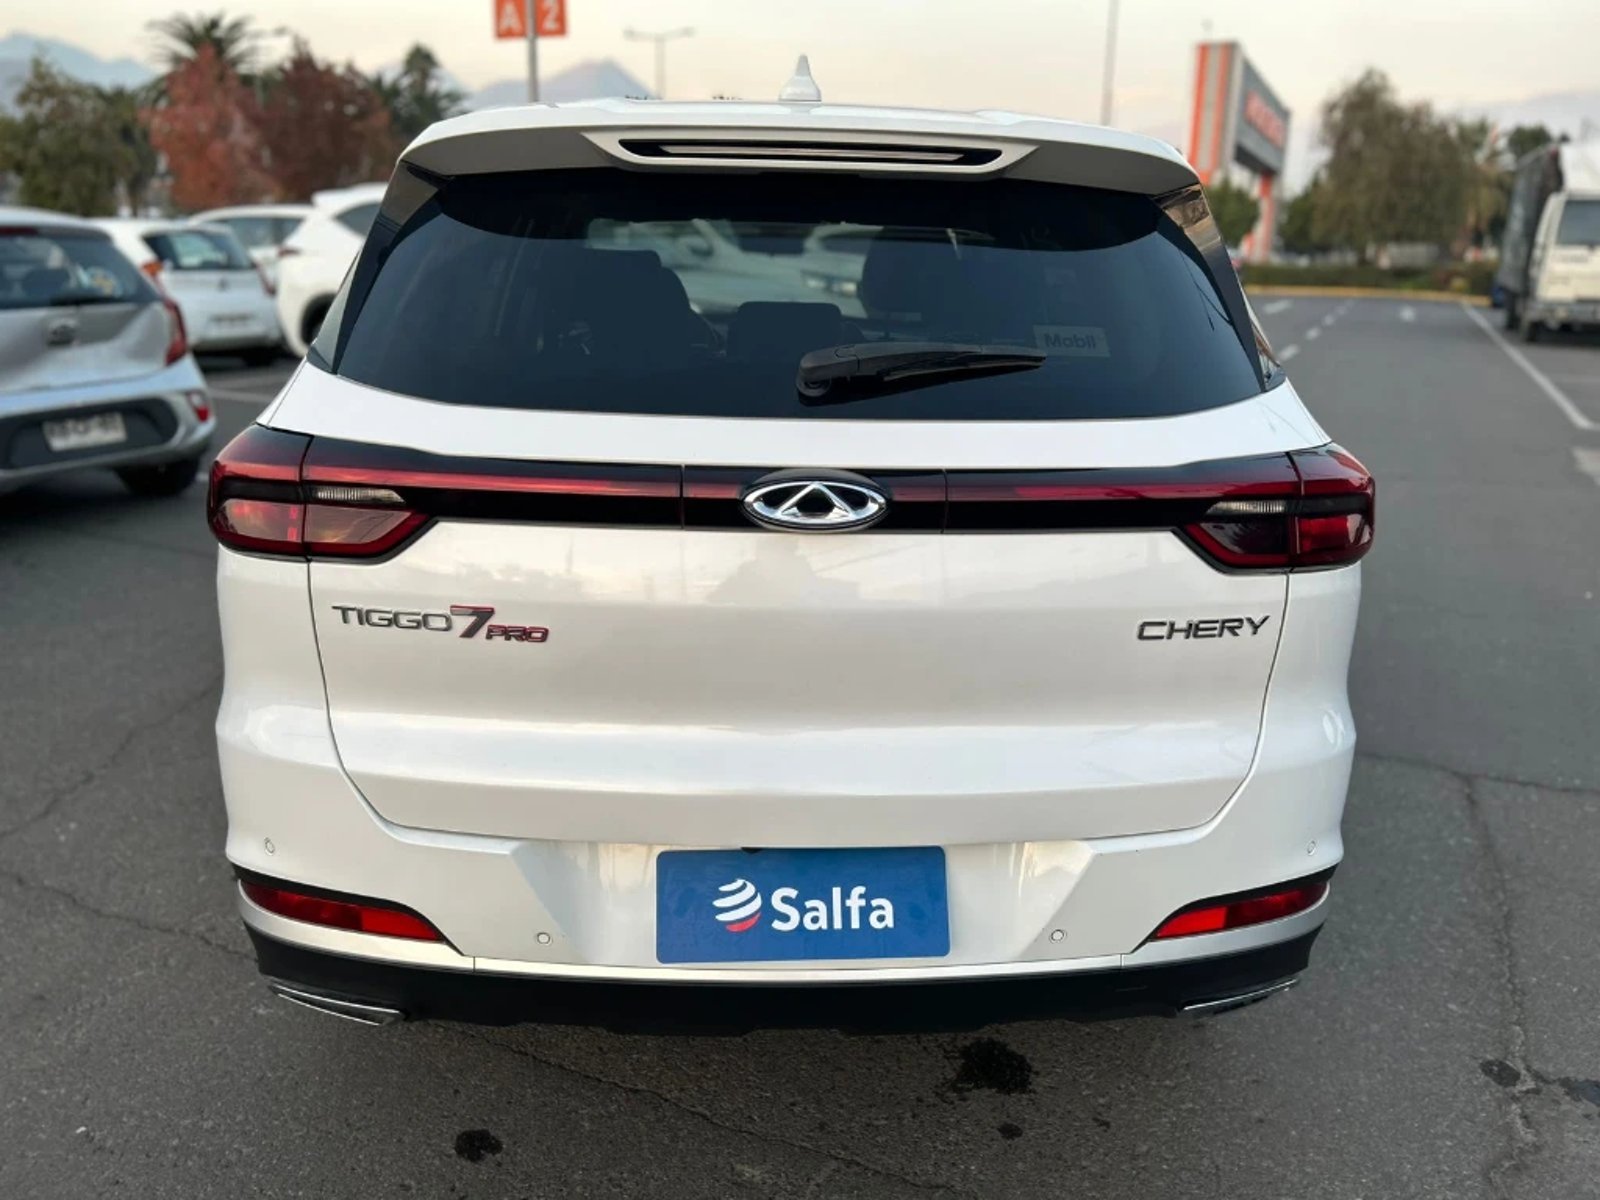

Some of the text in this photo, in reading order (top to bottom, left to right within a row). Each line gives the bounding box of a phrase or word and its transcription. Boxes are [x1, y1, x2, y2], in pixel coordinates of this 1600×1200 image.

[498, 0, 561, 33] A 2
[1043, 333, 1096, 349] Mobil
[331, 604, 549, 642] TIGGO 7 PRO
[1137, 615, 1271, 641] CHERY
[770, 886, 895, 931] Salfa
